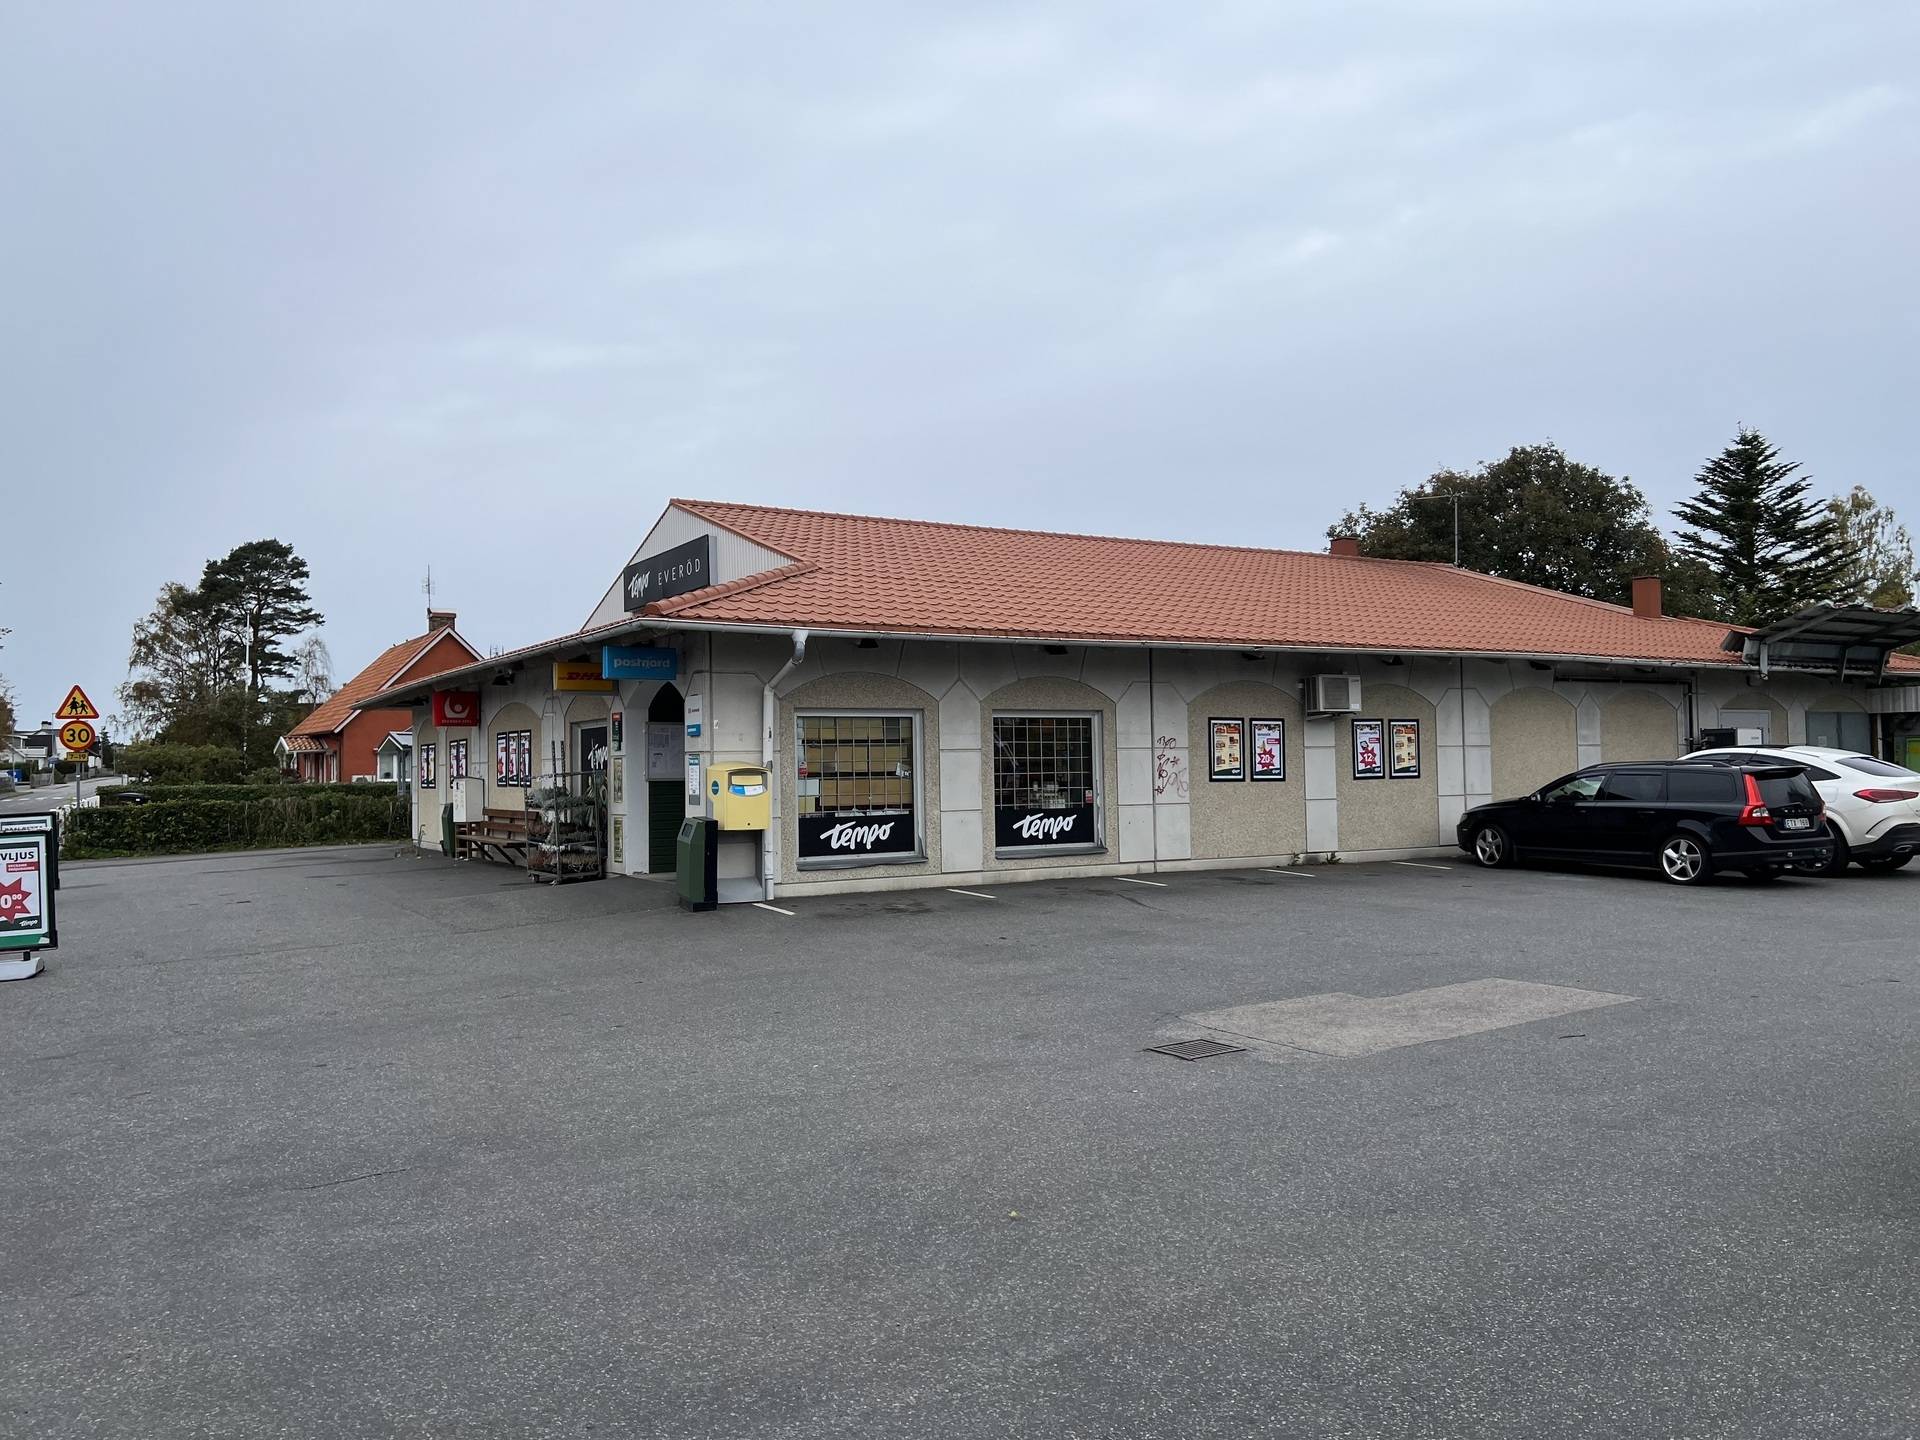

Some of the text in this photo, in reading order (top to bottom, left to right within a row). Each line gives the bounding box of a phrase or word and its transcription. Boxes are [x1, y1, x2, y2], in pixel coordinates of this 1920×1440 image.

[658, 558, 701, 586] EVERÖD
[613, 656, 671, 669] postnord
[66, 728, 91, 743] 30
[0, 851, 35, 862] VLJUS
